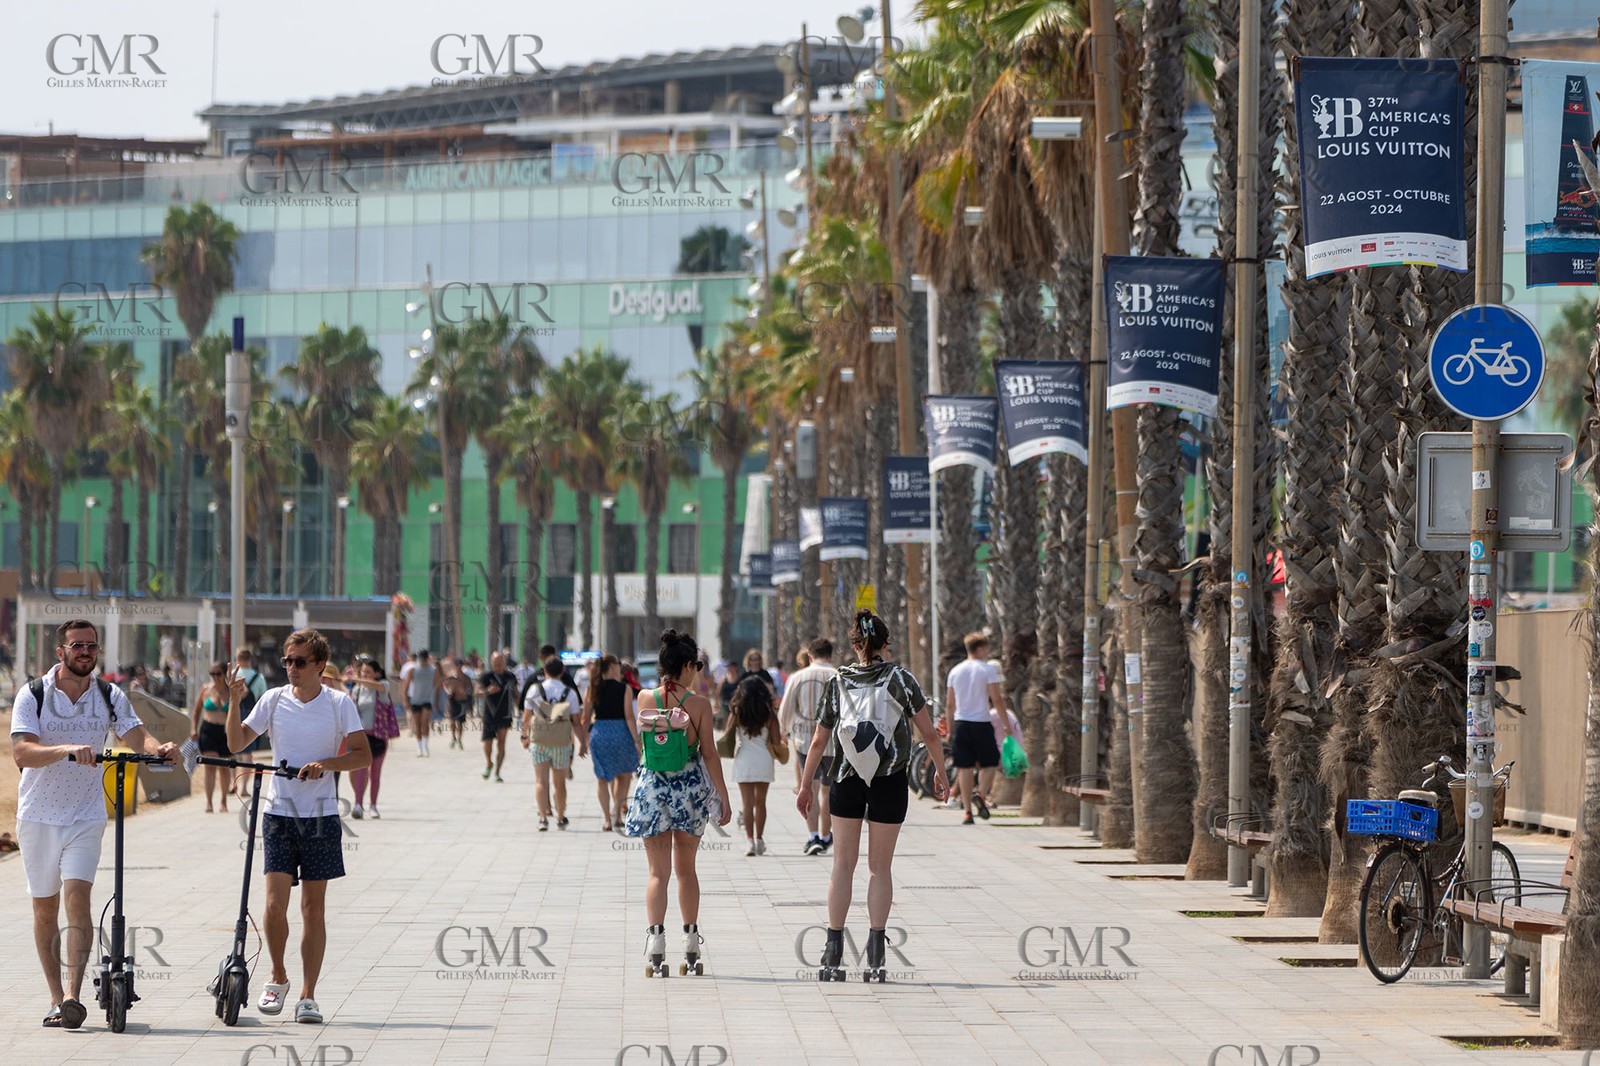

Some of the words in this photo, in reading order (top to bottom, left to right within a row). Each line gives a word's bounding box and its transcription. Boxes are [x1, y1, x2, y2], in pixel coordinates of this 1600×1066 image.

[1368, 97, 1399, 108] 37TH
[1369, 111, 1451, 125] AMERICA'S
[1369, 126, 1399, 137] CUP
[1318, 142, 1370, 159] LOUIS
[1375, 142, 1451, 159] VUITTON
[405, 160, 490, 192] AMERICAN
[494, 158, 550, 187] MAGIC
[1320, 194, 1334, 206] 22
[1337, 190, 1382, 203] AGOST
[1393, 190, 1451, 204] OCTUBRE
[1370, 204, 1403, 215] 2024
[1311, 251, 1327, 261] LOUIS
[1328, 248, 1352, 257] VUITTON
[1156, 284, 1179, 293] 37TH
[1156, 295, 1215, 309] AMERICA'S
[1156, 305, 1179, 314] CUP
[1119, 316, 1158, 327] LOUIS
[1161, 316, 1214, 333] VUITTON
[1120, 351, 1131, 361] 22
[1132, 350, 1165, 359] AGOST
[1172, 352, 1211, 368] OCTUBRE
[1156, 361, 1179, 370] 2024
[1010, 396, 1040, 407] LOUIS
[1041, 396, 1081, 408] VUITTON
